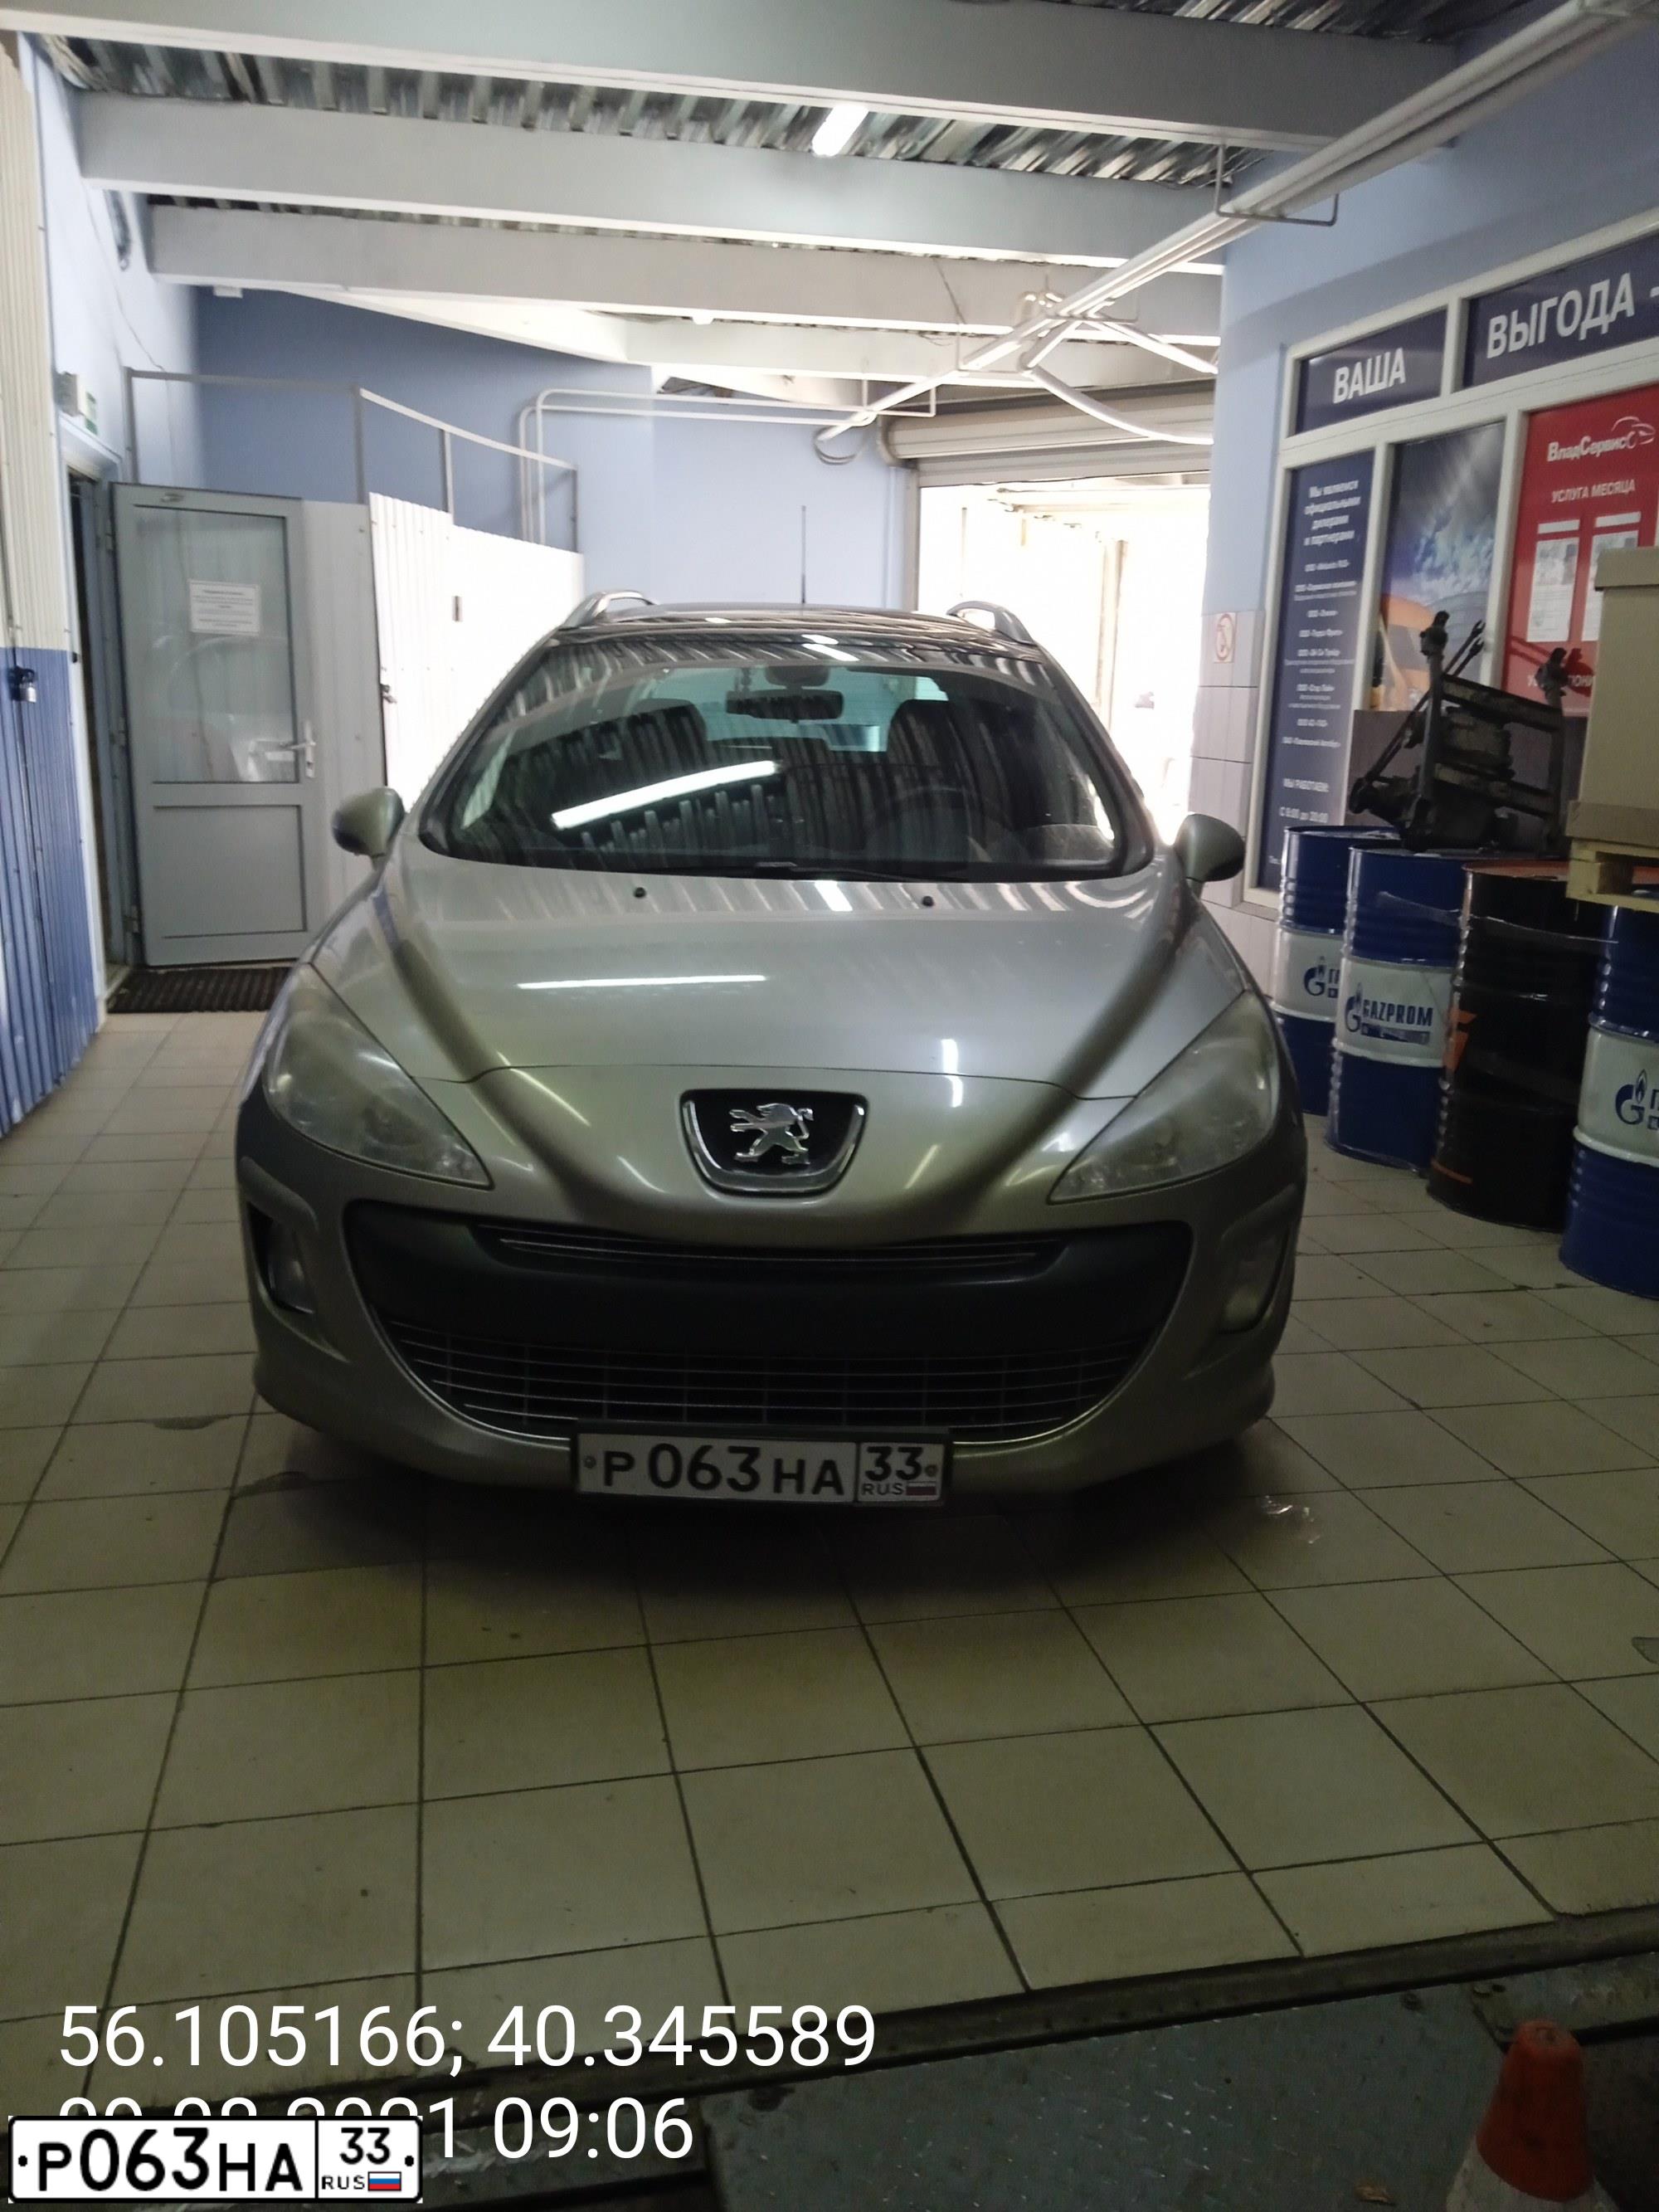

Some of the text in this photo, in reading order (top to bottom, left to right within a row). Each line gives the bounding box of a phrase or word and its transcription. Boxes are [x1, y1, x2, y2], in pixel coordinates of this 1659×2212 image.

[1333, 348, 1406, 403] ВАША
[1486, 273, 1635, 358] ВЫГОДА
[1551, 479, 1635, 503] УСЛУГА МЕСЯЦА
[1363, 999, 1433, 1026] GAZPROM
[865, 1446, 924, 1481] 33
[862, 1483, 903, 1495] RUS
